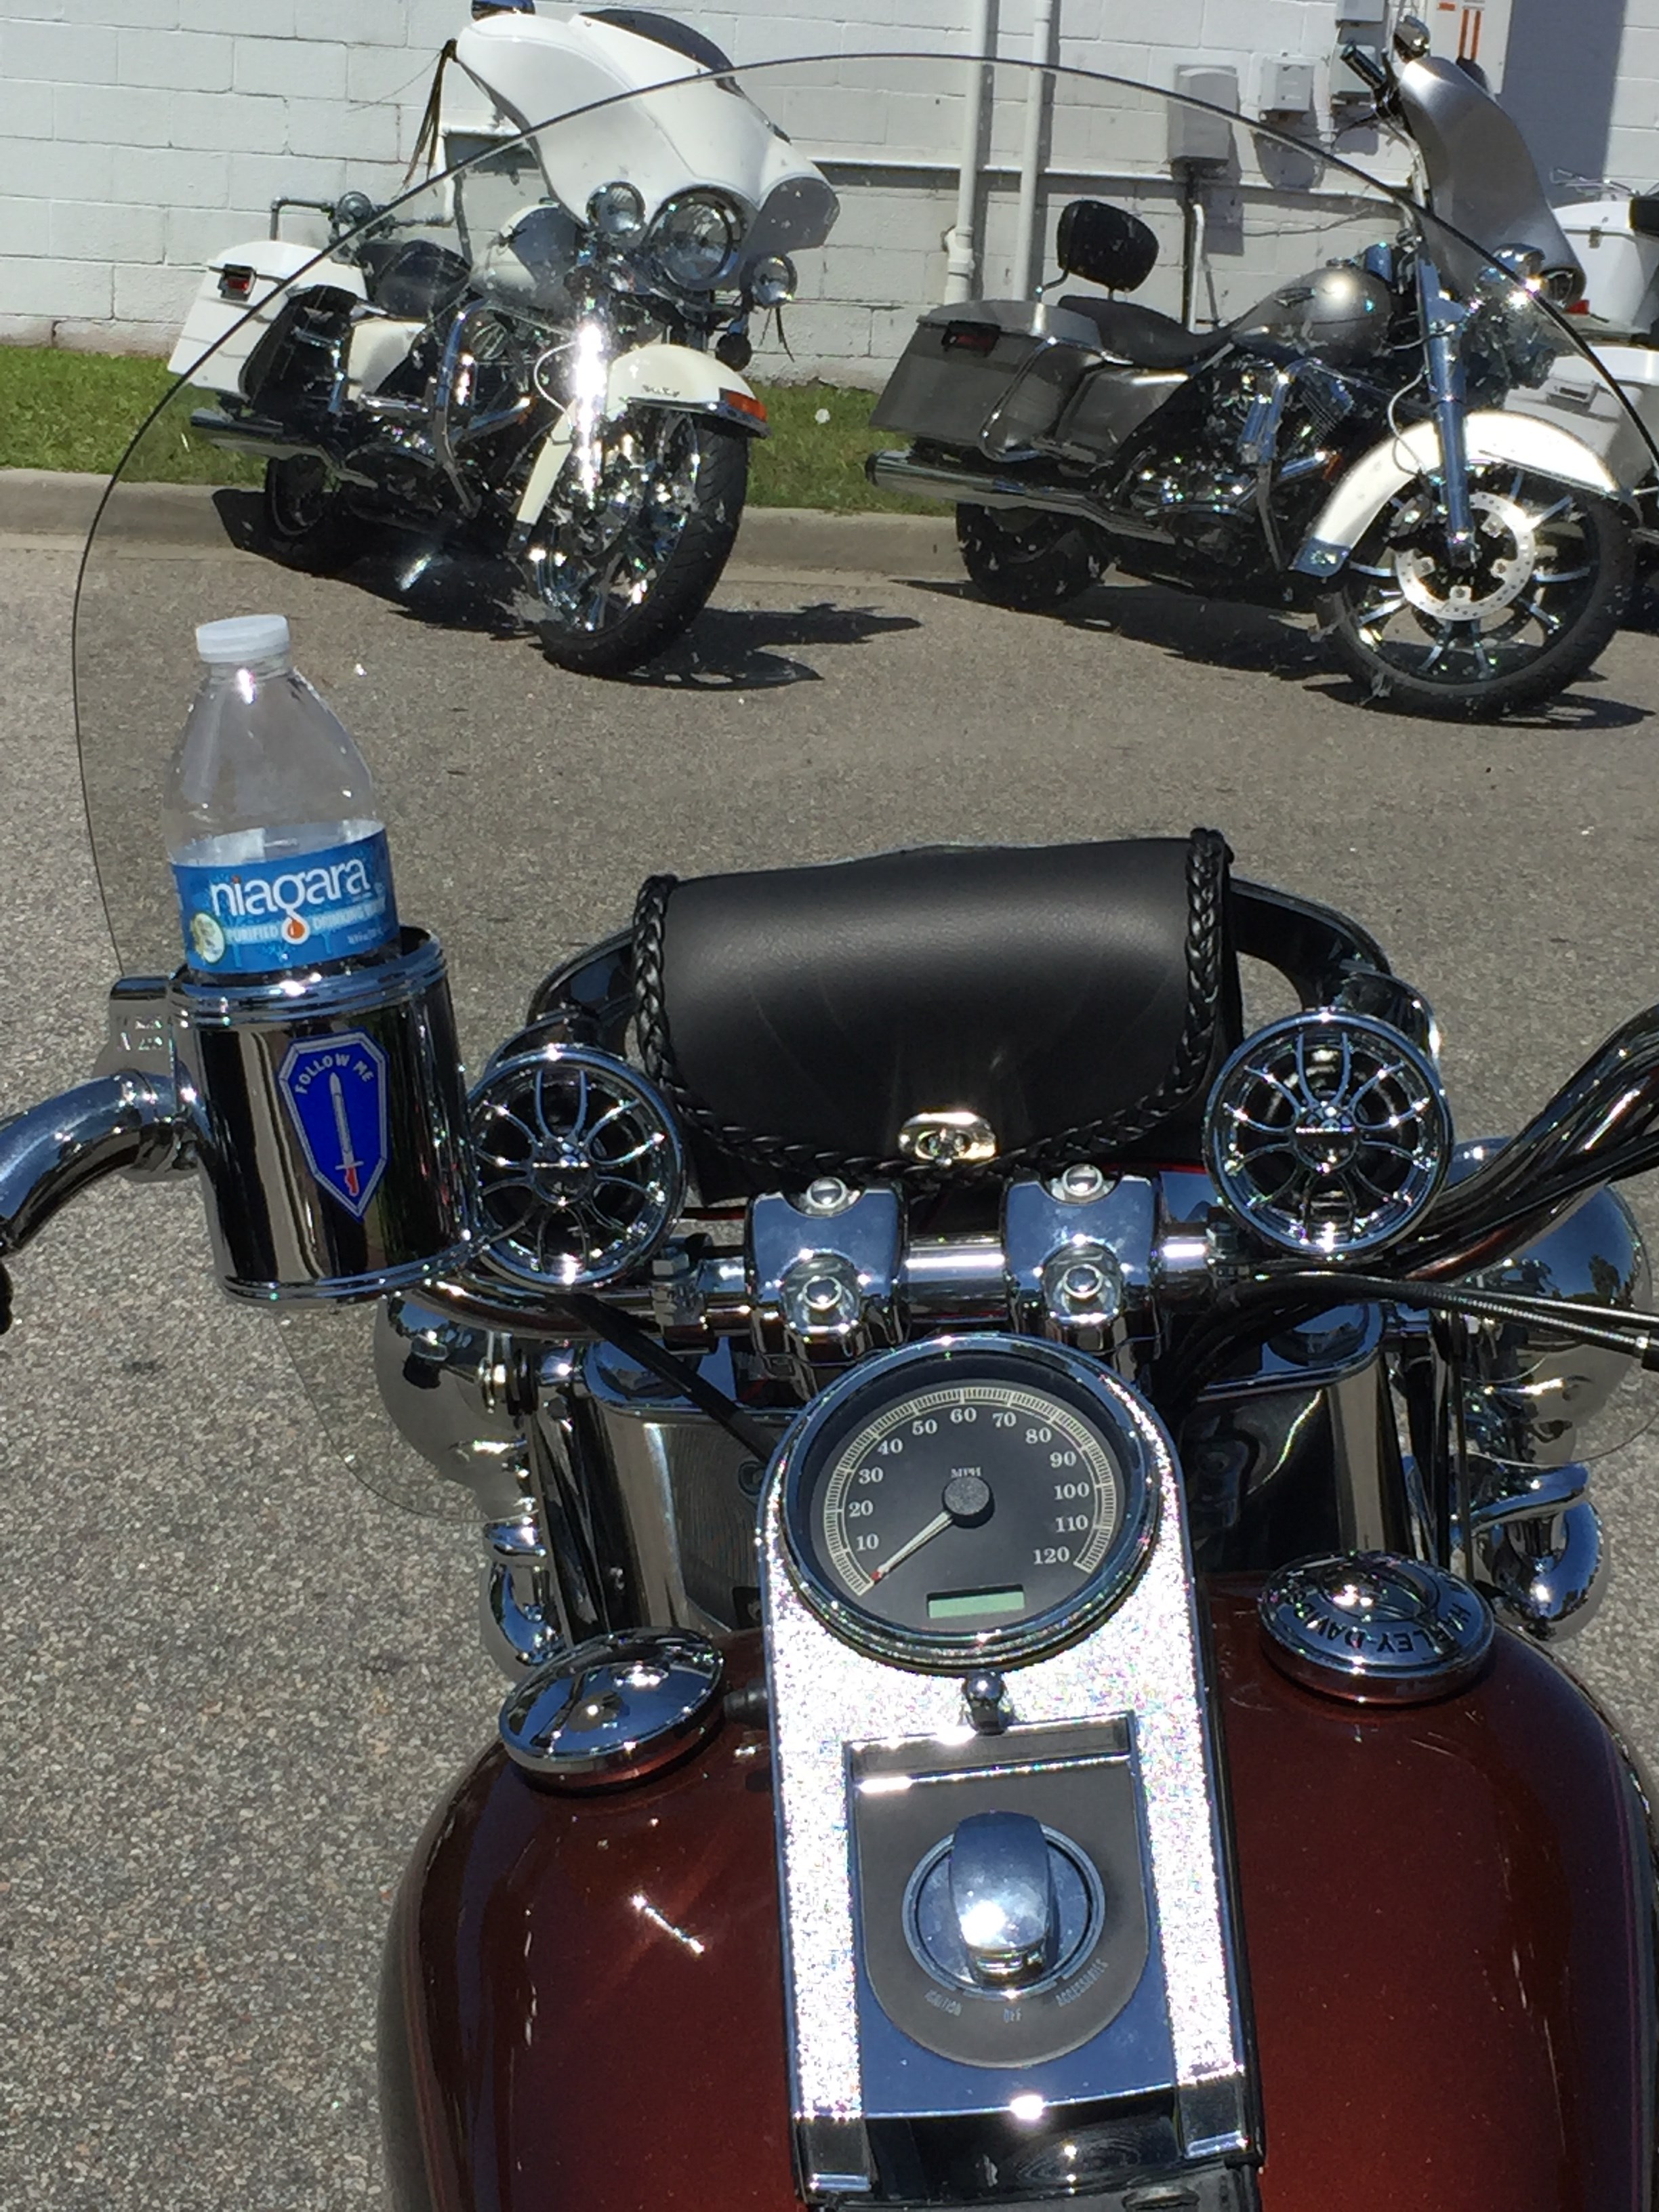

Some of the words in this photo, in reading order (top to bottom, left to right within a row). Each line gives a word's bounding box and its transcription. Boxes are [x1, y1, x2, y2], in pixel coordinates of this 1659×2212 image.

[209, 859, 371, 944] niagara
[227, 923, 278, 943] PURIFIED
[295, 1053, 350, 1094] FOLLOW
[353, 1061, 375, 1083] ME
[950, 1408, 977, 1422] 60
[993, 1412, 1017, 1427] 70
[912, 1420, 937, 1435] 50
[1026, 1427, 1052, 1443] 80
[877, 1437, 903, 1454] 40
[1050, 1452, 1076, 1467] 90
[859, 1467, 883, 1483] 30
[951, 1466, 981, 1478] MPH
[1054, 1482, 1090, 1500] 100
[849, 1500, 874, 1517] 20
[1056, 1515, 1088, 1532] 110
[857, 1534, 879, 1551] 10
[1035, 1547, 1069, 1564] 120
[1055, 1958, 1109, 2007] ACCESSORIES
[924, 1989, 962, 2017] IGNITION
[1003, 2007, 1022, 2024] OFF
